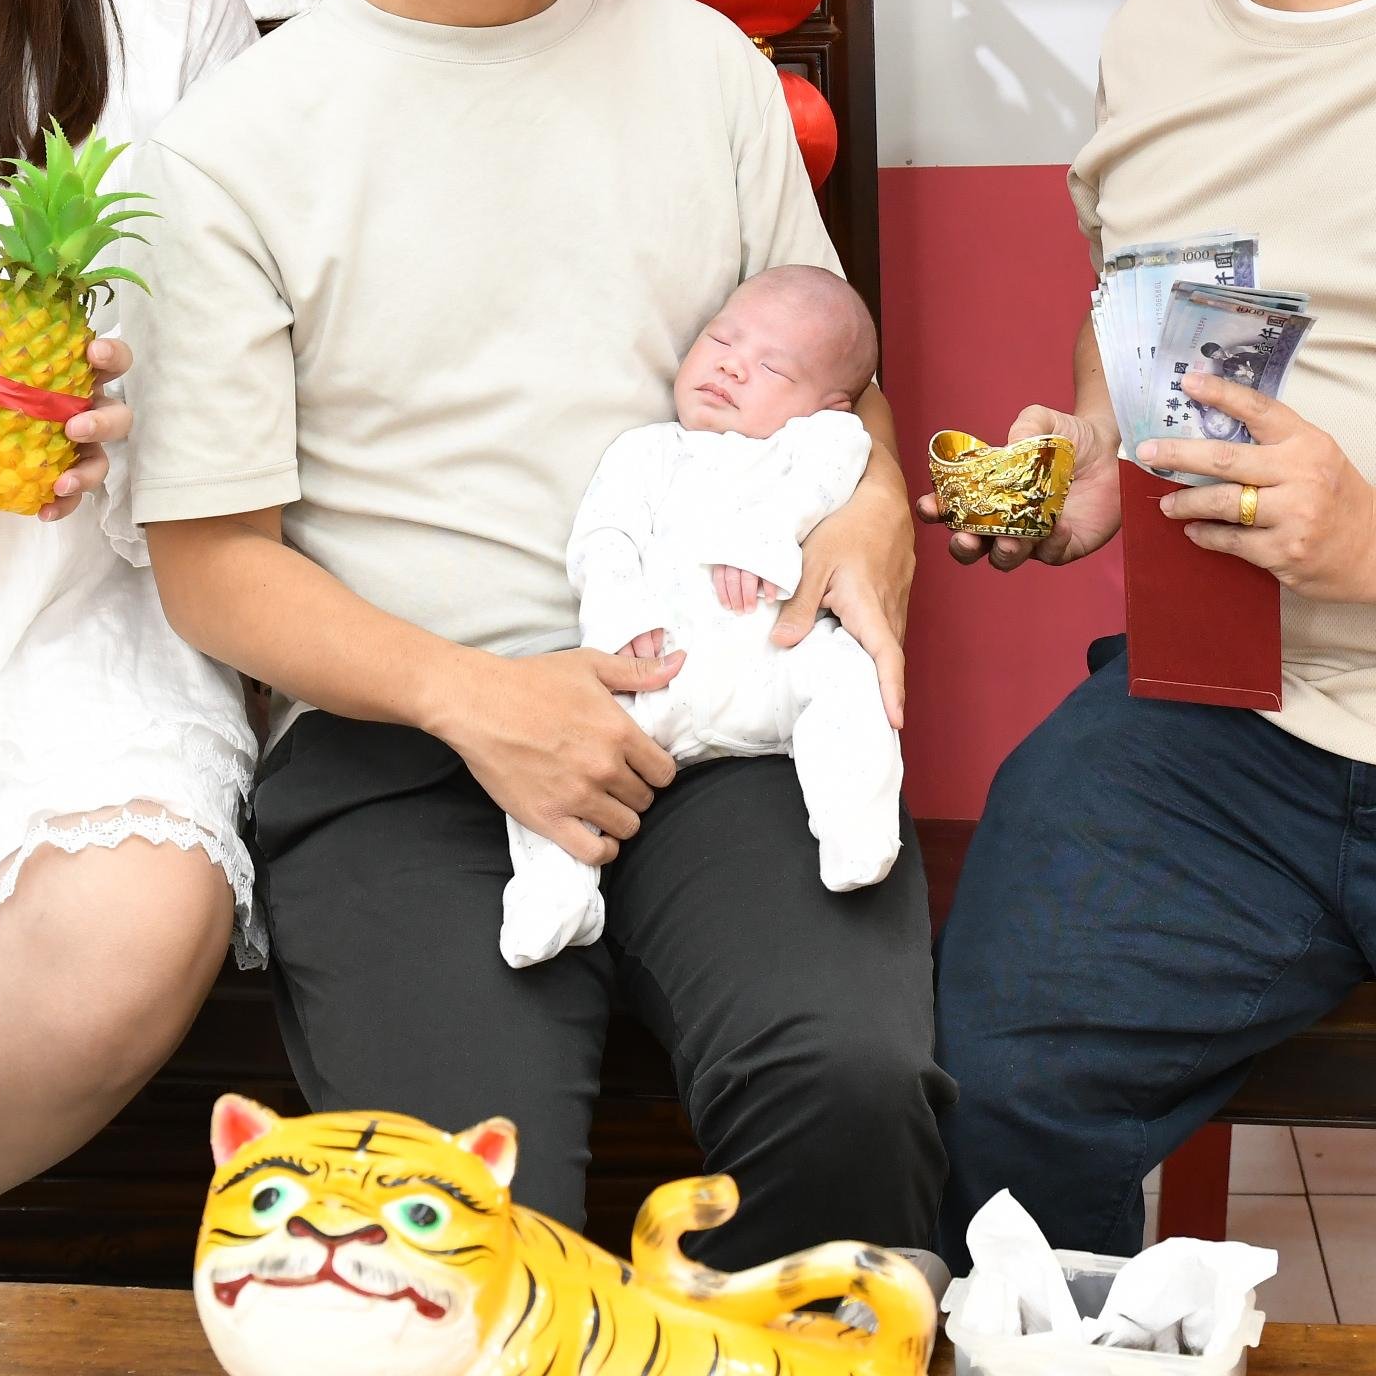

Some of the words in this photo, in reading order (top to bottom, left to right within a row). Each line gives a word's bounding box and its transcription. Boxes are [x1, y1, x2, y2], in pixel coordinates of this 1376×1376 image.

[1182, 250, 1210, 262] 1000
[1253, 315, 1289, 354] 壹仟圓
[1162, 361, 1189, 427] 中華民國
